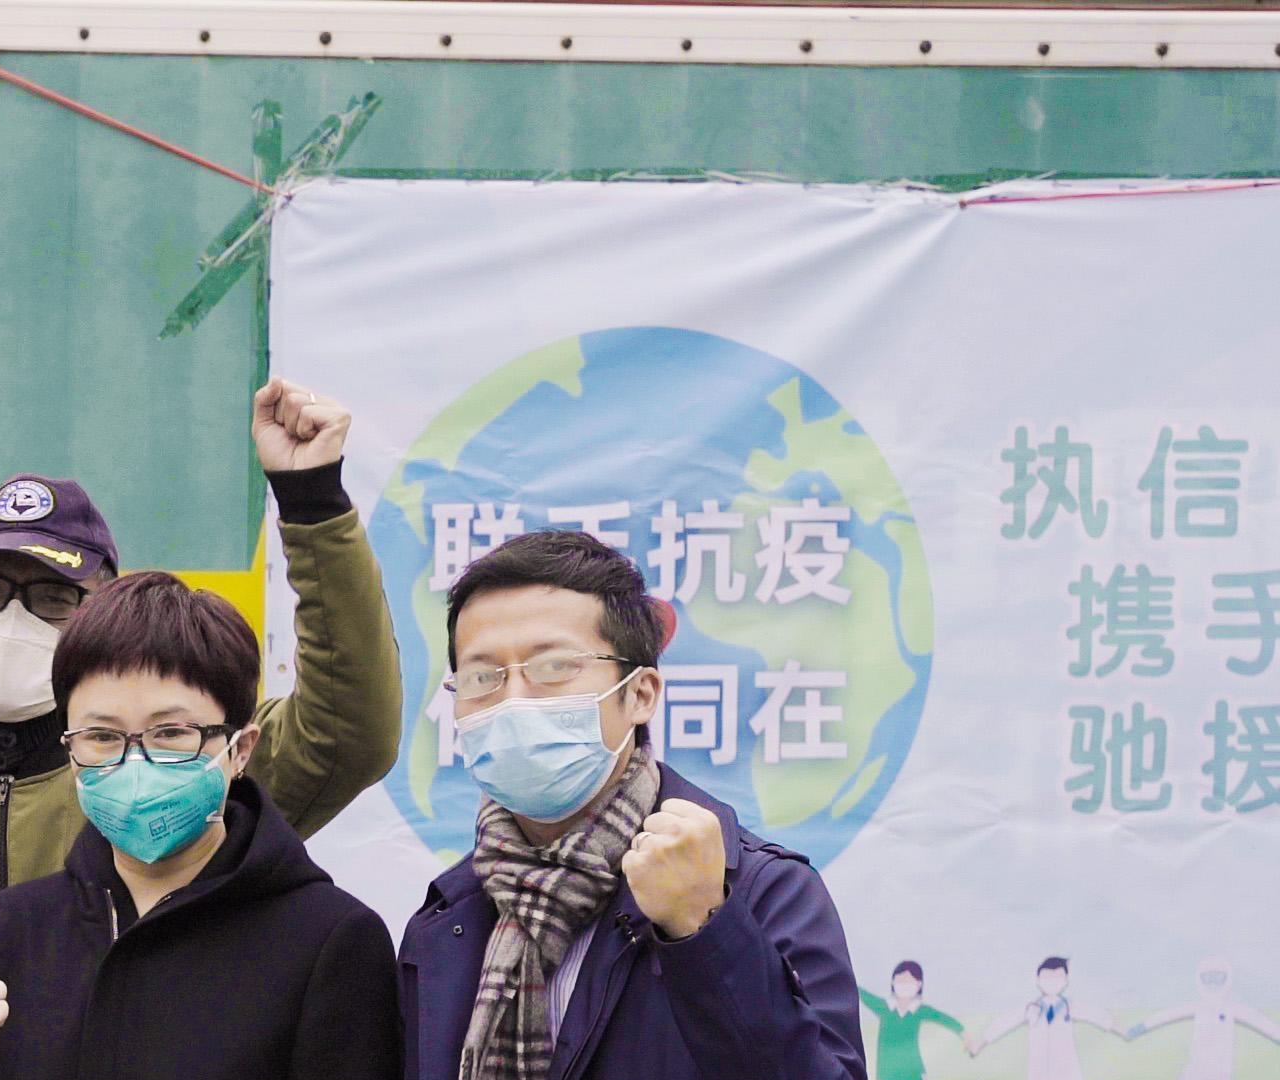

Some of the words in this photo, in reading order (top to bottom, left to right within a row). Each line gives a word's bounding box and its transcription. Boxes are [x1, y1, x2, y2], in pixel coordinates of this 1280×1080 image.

[1000, 425, 1249, 540] 执信
[1066, 563, 1280, 678] 携手
[1064, 700, 1280, 813] 驰援
